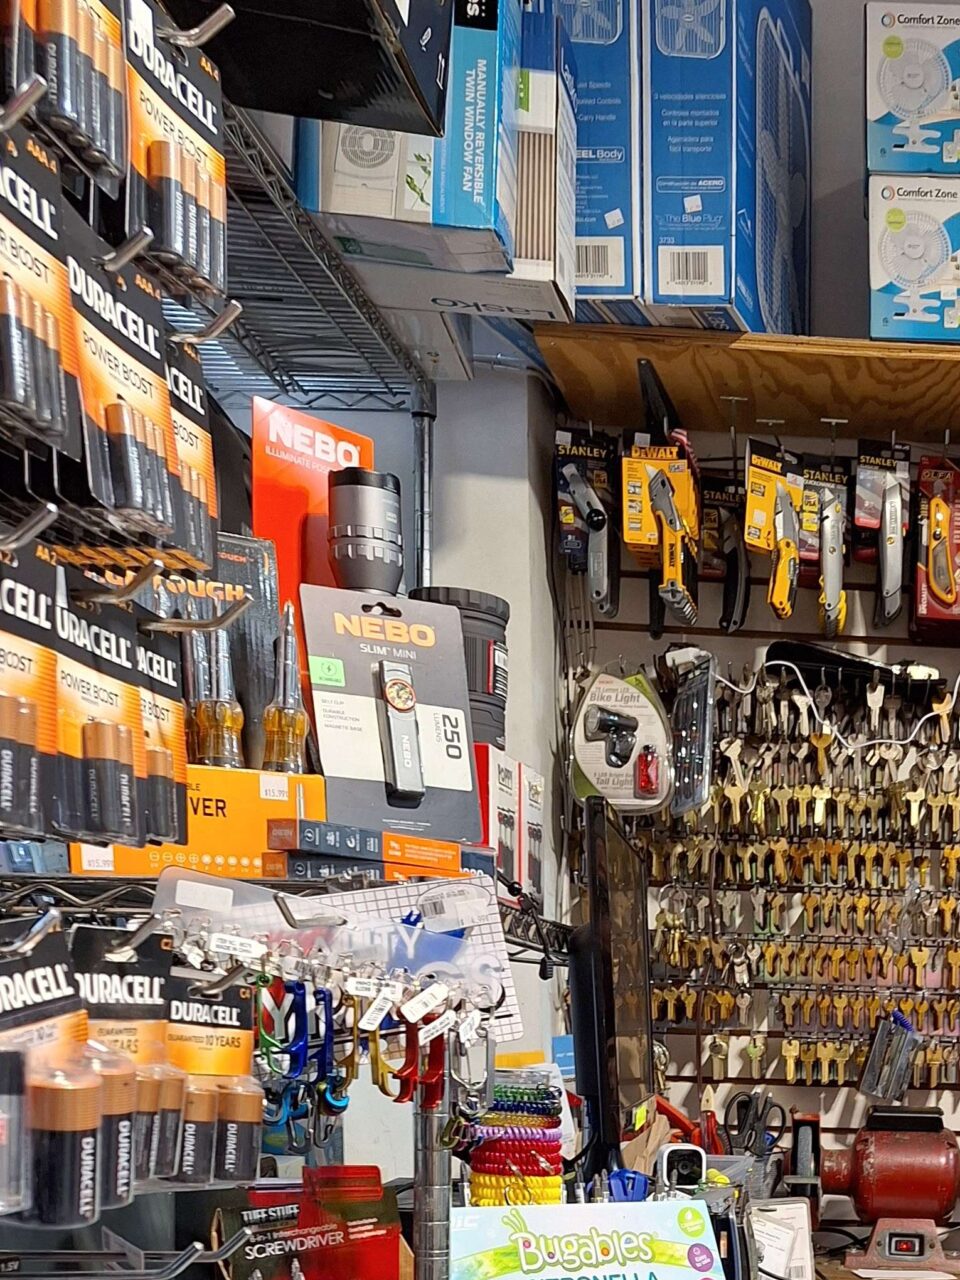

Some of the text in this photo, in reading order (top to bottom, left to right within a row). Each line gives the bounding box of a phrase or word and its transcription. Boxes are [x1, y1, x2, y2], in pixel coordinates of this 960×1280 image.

[897, 14, 960, 26] Comfort Zone
[128, 18, 218, 136] DURACELL
[462, 69, 475, 192] TWIN WINDOW FAN
[473, 59, 487, 204] MANUALLY REVERSIBLE
[896, 187, 958, 200] Comfort Zone
[682, 214, 702, 223] Blue
[67, 256, 161, 359] DURACELL
[82, 331, 155, 399] POWER BOOST
[269, 414, 362, 468] NEBO
[557, 445, 608, 459] STANLEY
[859, 455, 898, 467] STANLEY
[803, 469, 848, 485] STANLEY
[333, 612, 436, 648] NEBO
[60, 669, 120, 709] POWER BOOST
[589, 692, 641, 703] Bike Light
[402, 735, 412, 769] NEBO
[442, 713, 462, 760] 250
[171, 1001, 241, 1027] DURACELL
[205, 1034, 213, 1044] 10
[214, 1034, 241, 1048] YEARS
[116, 1120, 130, 1197] DURACELL
[182, 1123, 195, 1175] DURACELL
[225, 1122, 238, 1172] DURACELL
[80, 1136, 95, 1218] DURACELL
[245, 1231, 345, 1261] SCREWDRIVER
[513, 1225, 656, 1275] Bugables
